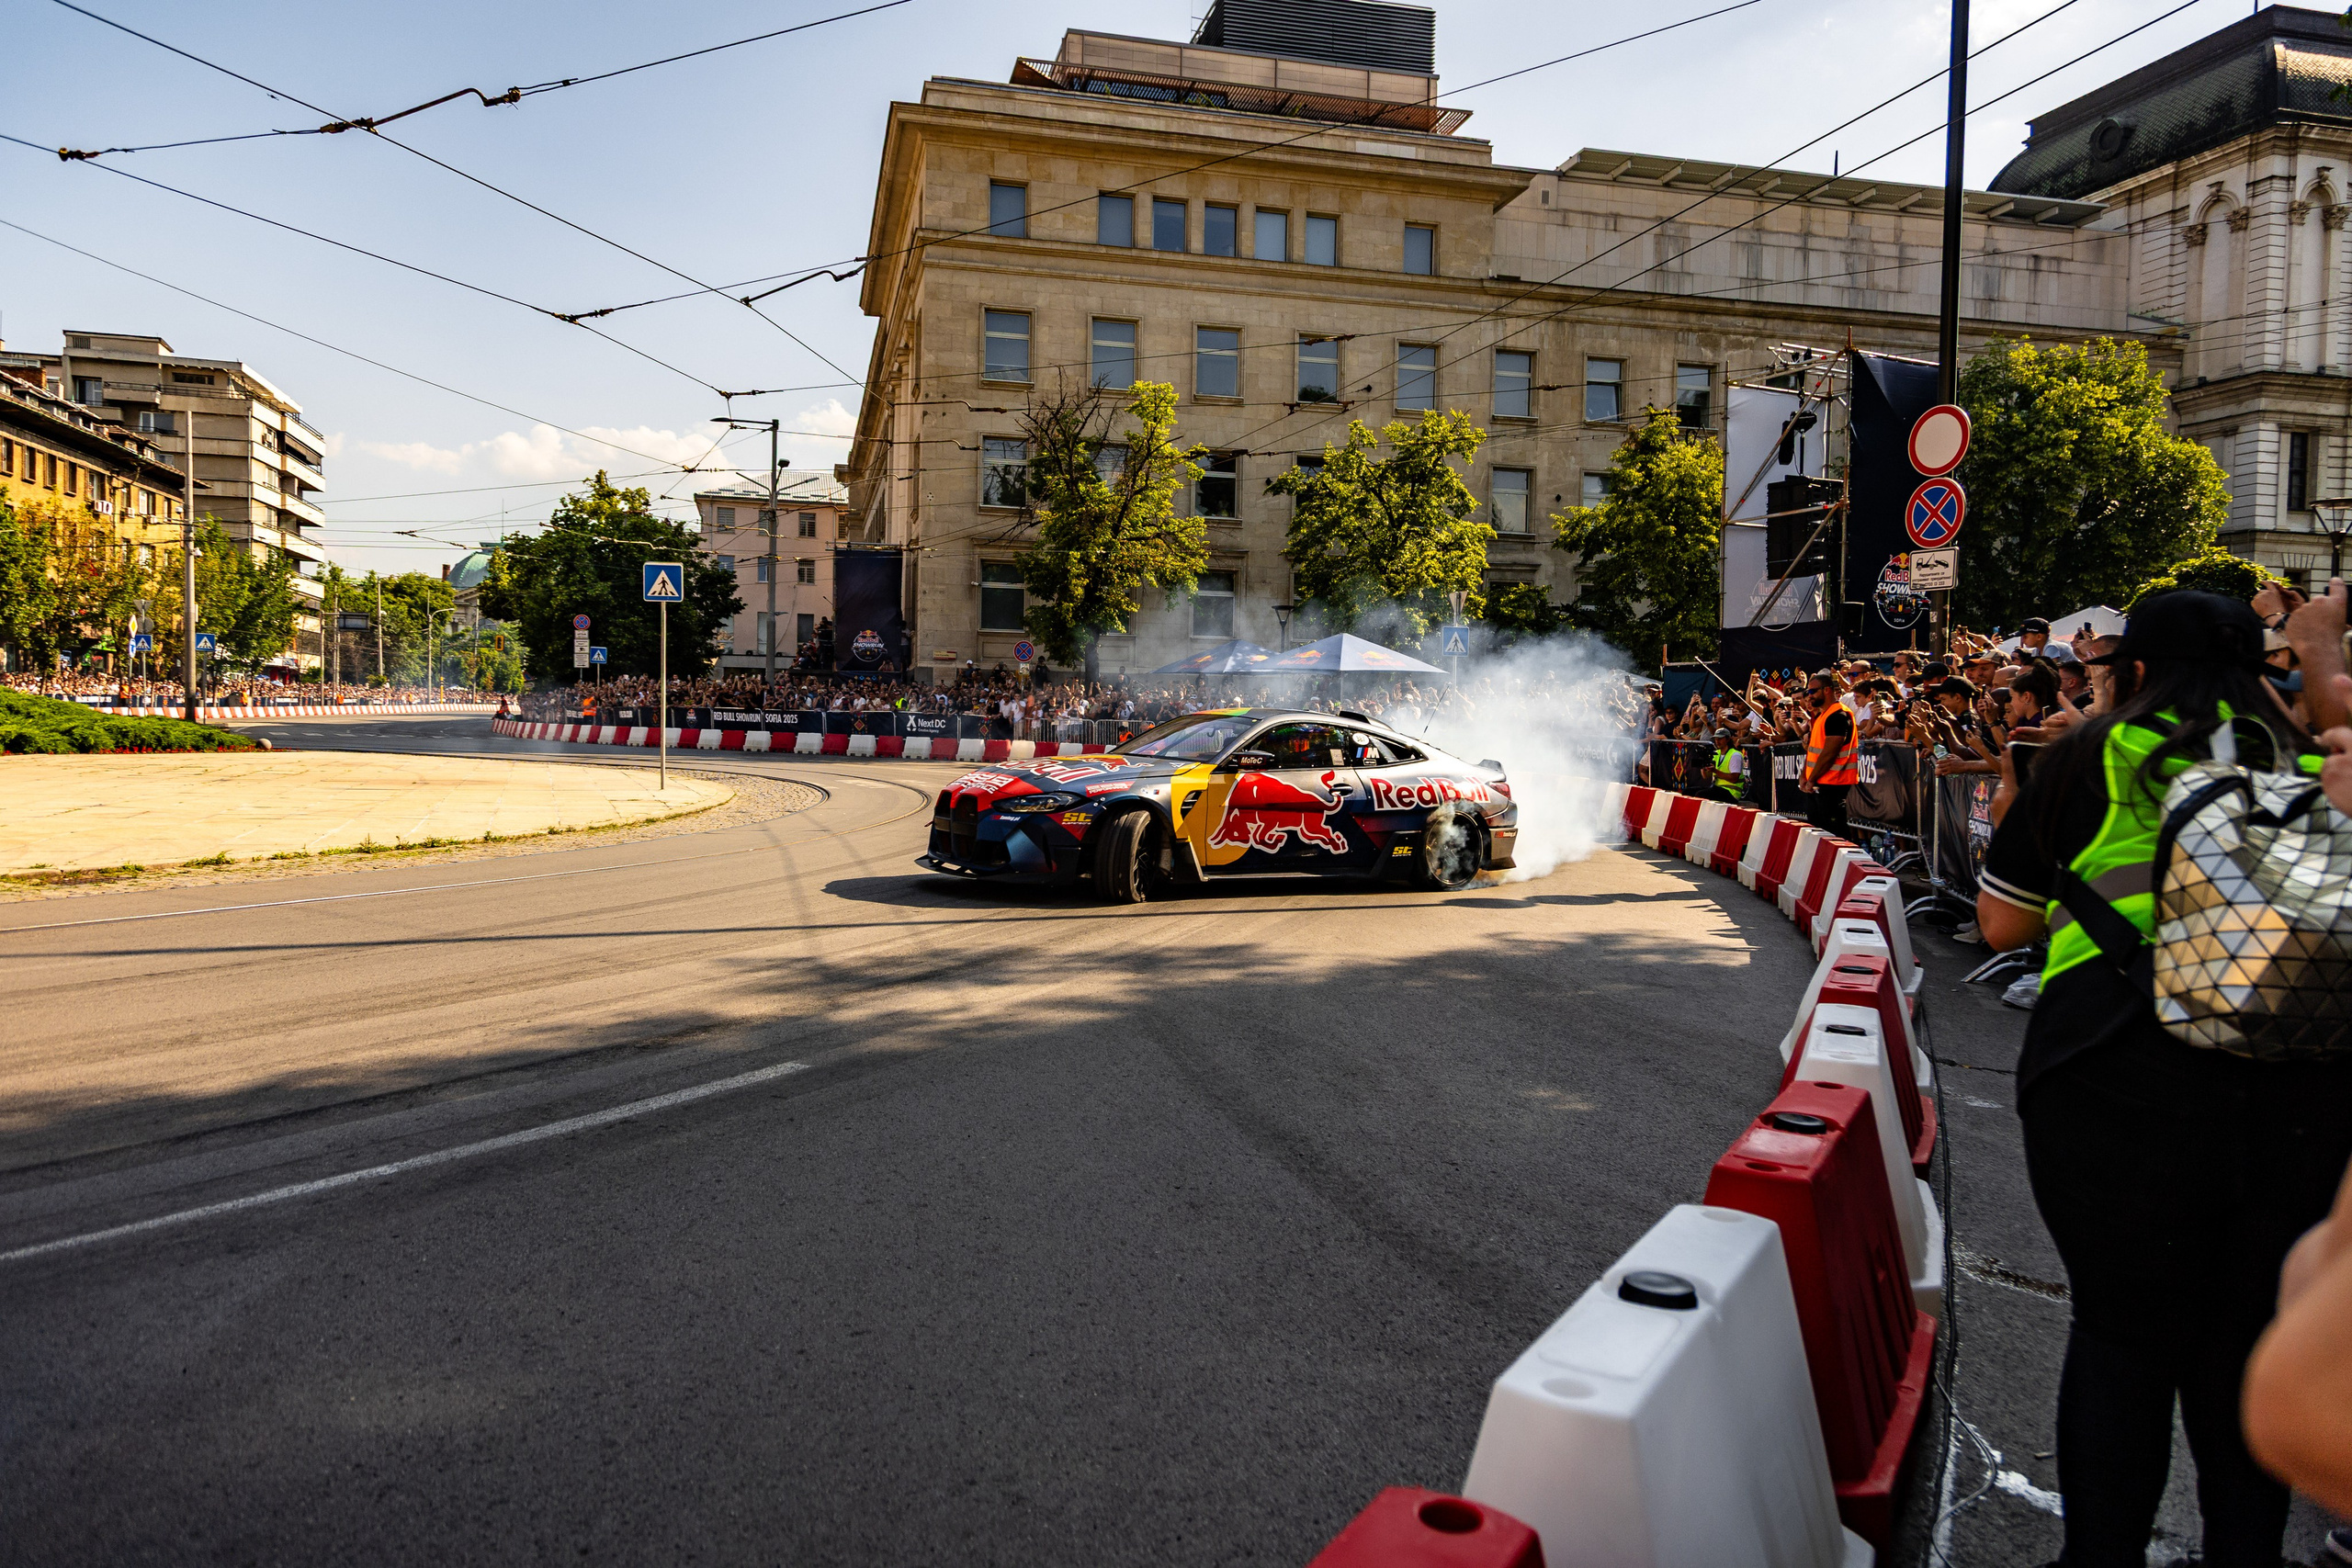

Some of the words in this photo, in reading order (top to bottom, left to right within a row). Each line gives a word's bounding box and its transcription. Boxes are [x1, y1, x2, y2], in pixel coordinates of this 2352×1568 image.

[1885, 569, 1902, 582] Red
[1876, 582, 1927, 595] SHOW
[714, 711, 723, 720] RED
[723, 712, 735, 722] BULL
[736, 712, 761, 723] SHOWRUN
[765, 713, 782, 724] SOFIA
[783, 714, 798, 724] 2025
[918, 718, 934, 728] Next
[934, 718, 946, 728] DC
[1240, 756, 1263, 765] MoTeC
[1774, 755, 1784, 779] RED
[1784, 754, 1796, 780] BULL
[1857, 754, 1877, 784] 025
[1368, 776, 1442, 810] Red
